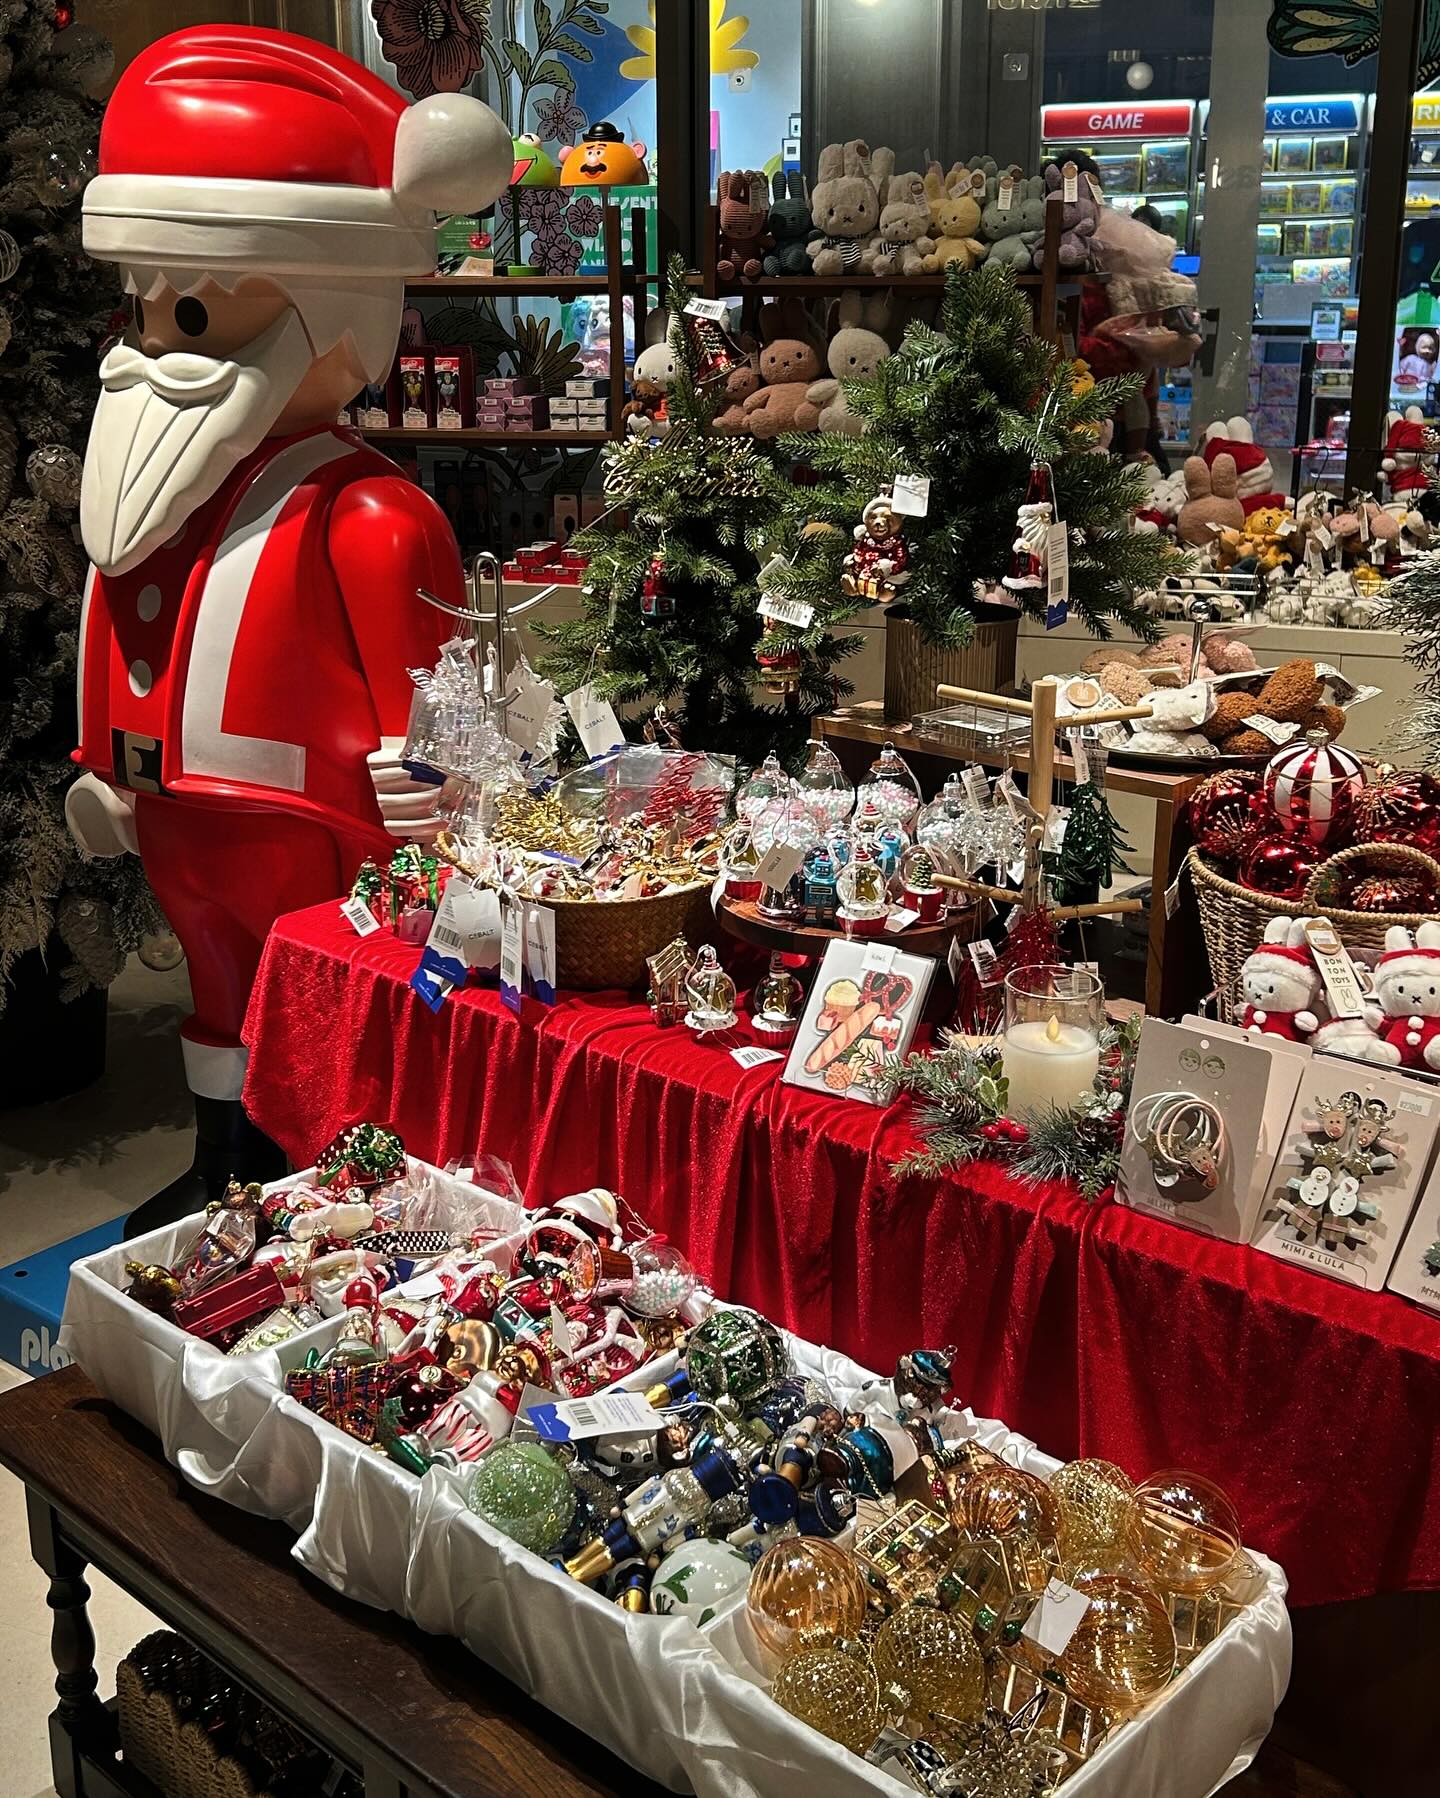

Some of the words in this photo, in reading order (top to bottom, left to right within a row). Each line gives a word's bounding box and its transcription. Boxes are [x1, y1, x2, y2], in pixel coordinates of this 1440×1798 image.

[1088, 112, 1144, 130] GAME
[1271, 109, 1287, 126] &
[1290, 108, 1331, 125] CAR
[1323, 958, 1342, 966] BON
[1327, 967, 1346, 975] TON
[1331, 976, 1351, 984] TOYS
[1281, 1242, 1306, 1256] MIMI
[1308, 1251, 1315, 1260] &
[1317, 1254, 1345, 1271] LULA
